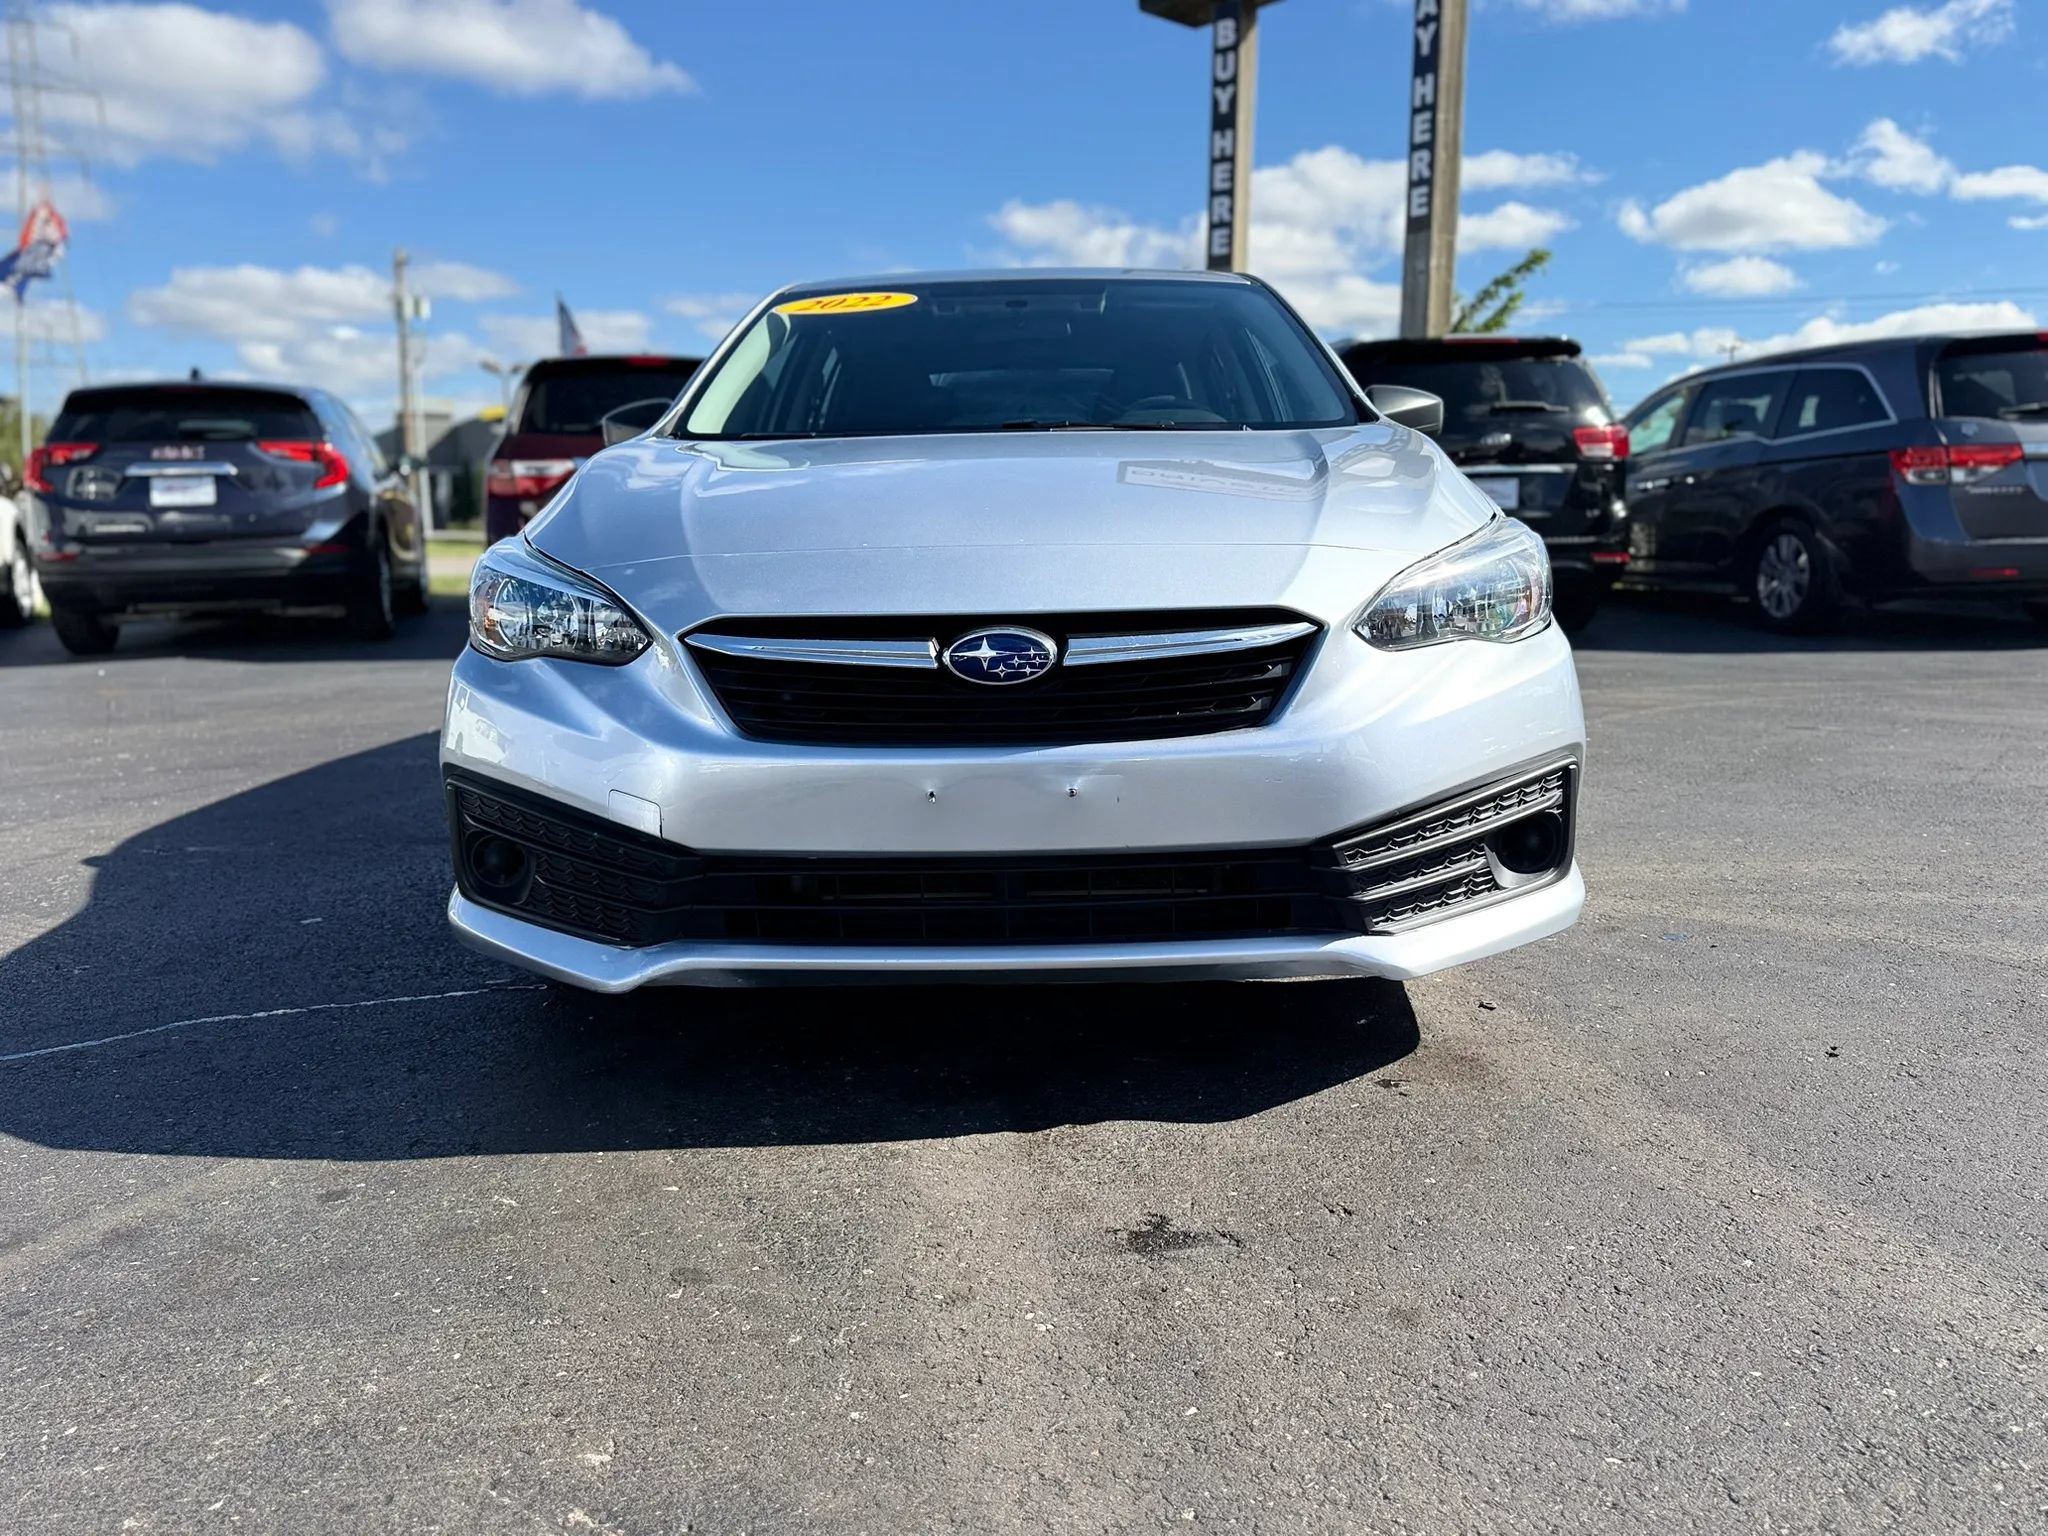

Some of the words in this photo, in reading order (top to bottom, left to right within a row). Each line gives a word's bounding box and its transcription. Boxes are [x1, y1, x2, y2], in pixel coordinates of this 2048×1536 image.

[1213, 17, 1238, 114] BUY
[1210, 128, 1234, 256] HERE
[1408, 73, 1435, 219] HERE
[793, 295, 893, 312] 2022
